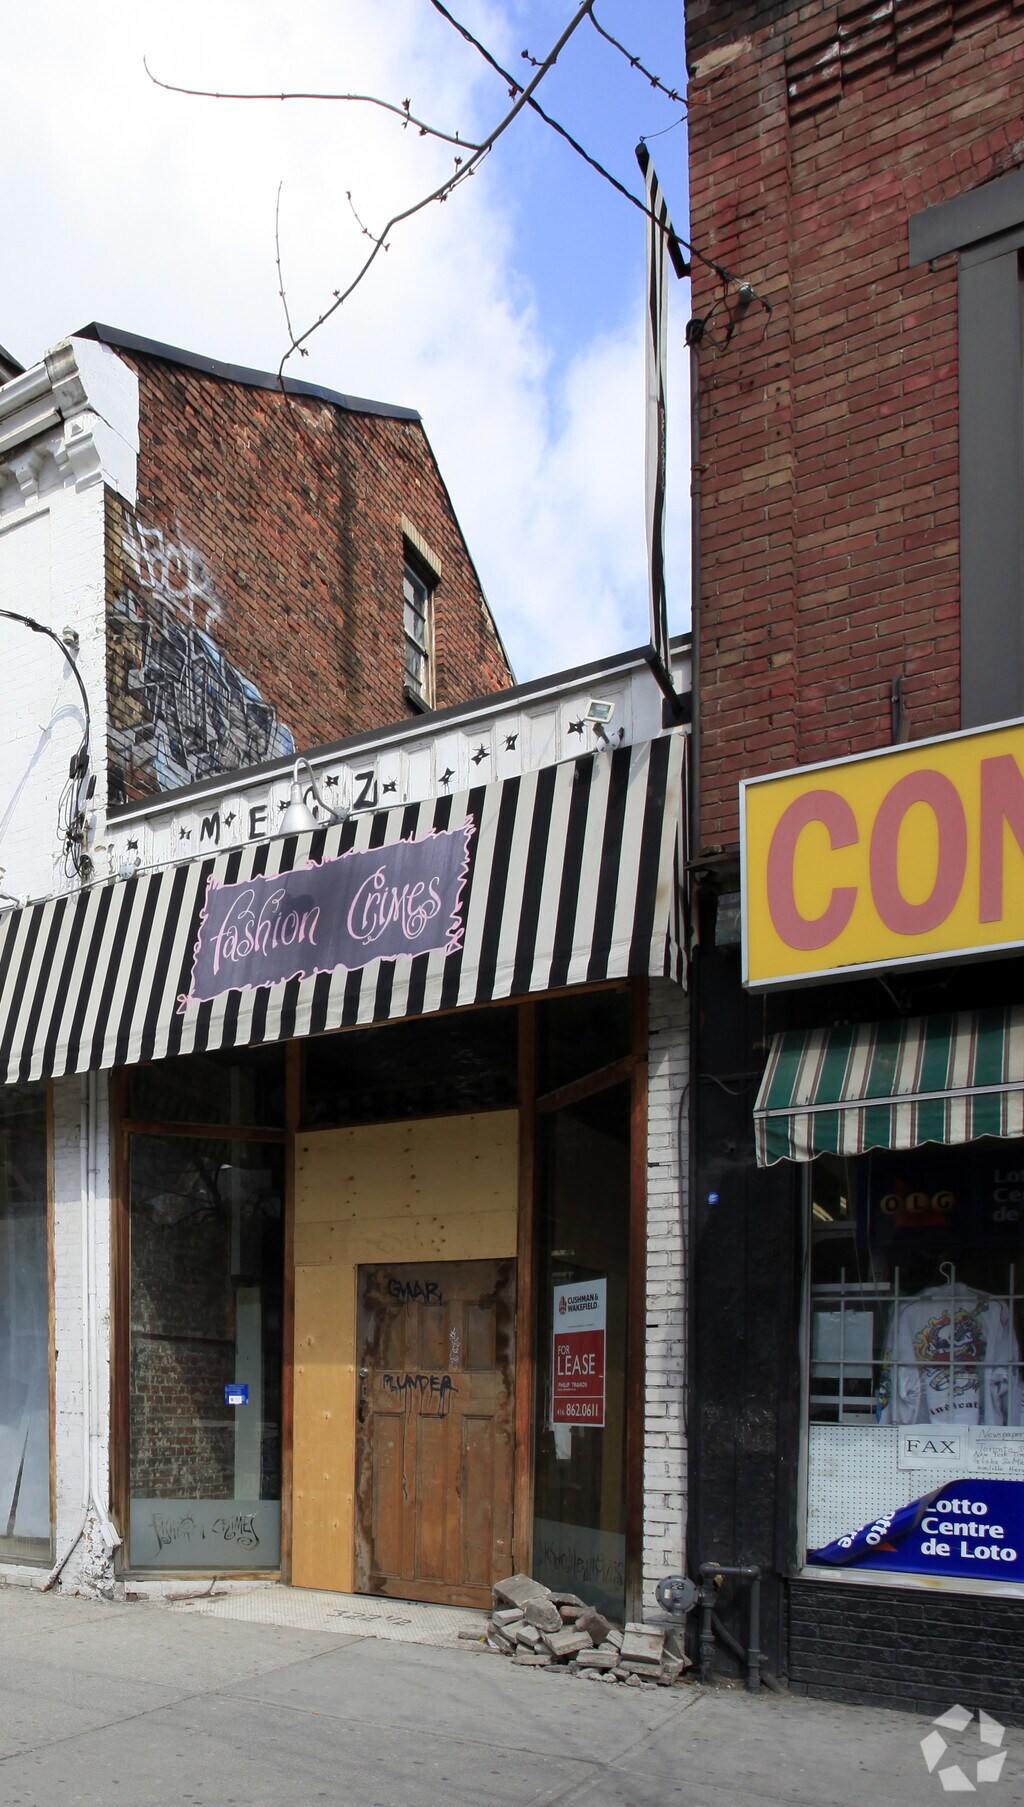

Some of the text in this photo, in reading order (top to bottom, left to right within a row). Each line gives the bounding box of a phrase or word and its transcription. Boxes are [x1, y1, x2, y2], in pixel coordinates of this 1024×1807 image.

[347, 865, 441, 945] Crimes
[567, 1294, 594, 1305] CUSHMAN
[557, 1345, 570, 1355] FOR
[557, 1354, 596, 1376] LEASE
[566, 1403, 598, 1417] 862.0611
[906, 1440, 956, 1454] FAX
[920, 1516, 1005, 1539] Centre
[920, 1538, 1017, 1562] de Loto
